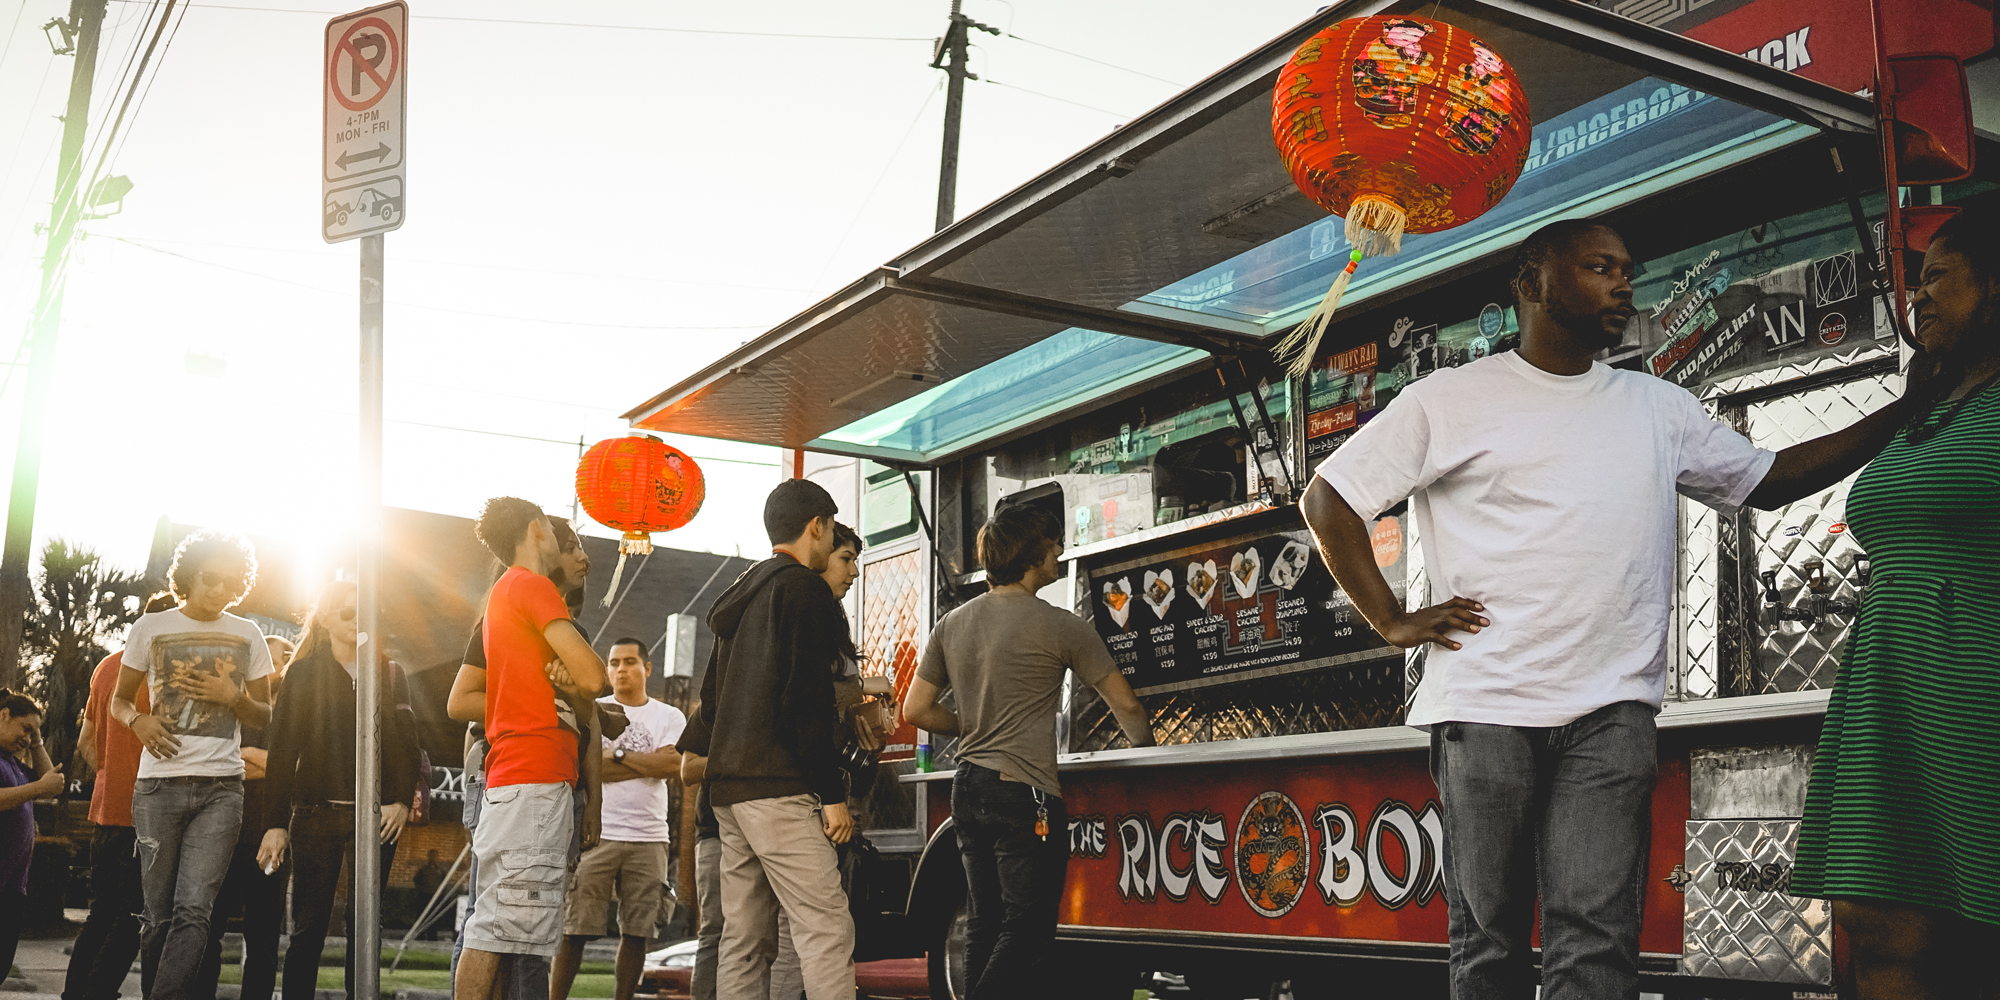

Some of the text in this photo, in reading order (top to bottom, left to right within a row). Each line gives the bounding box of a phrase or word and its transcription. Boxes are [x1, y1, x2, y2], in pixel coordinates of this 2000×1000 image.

[346, 109, 379, 127] 4-7PM
[336, 128, 361, 143] MON
[372, 120, 390, 134] FRI
[1676, 343, 1716, 385] ROAD
[1716, 303, 1757, 348] FLIRT
[1329, 350, 1358, 374] ALWAYS
[1360, 344, 1377, 364] RAD
[1334, 627, 1352, 637] $4.99
[1067, 820, 1106, 853] THE
[1118, 815, 1231, 899] RICE
